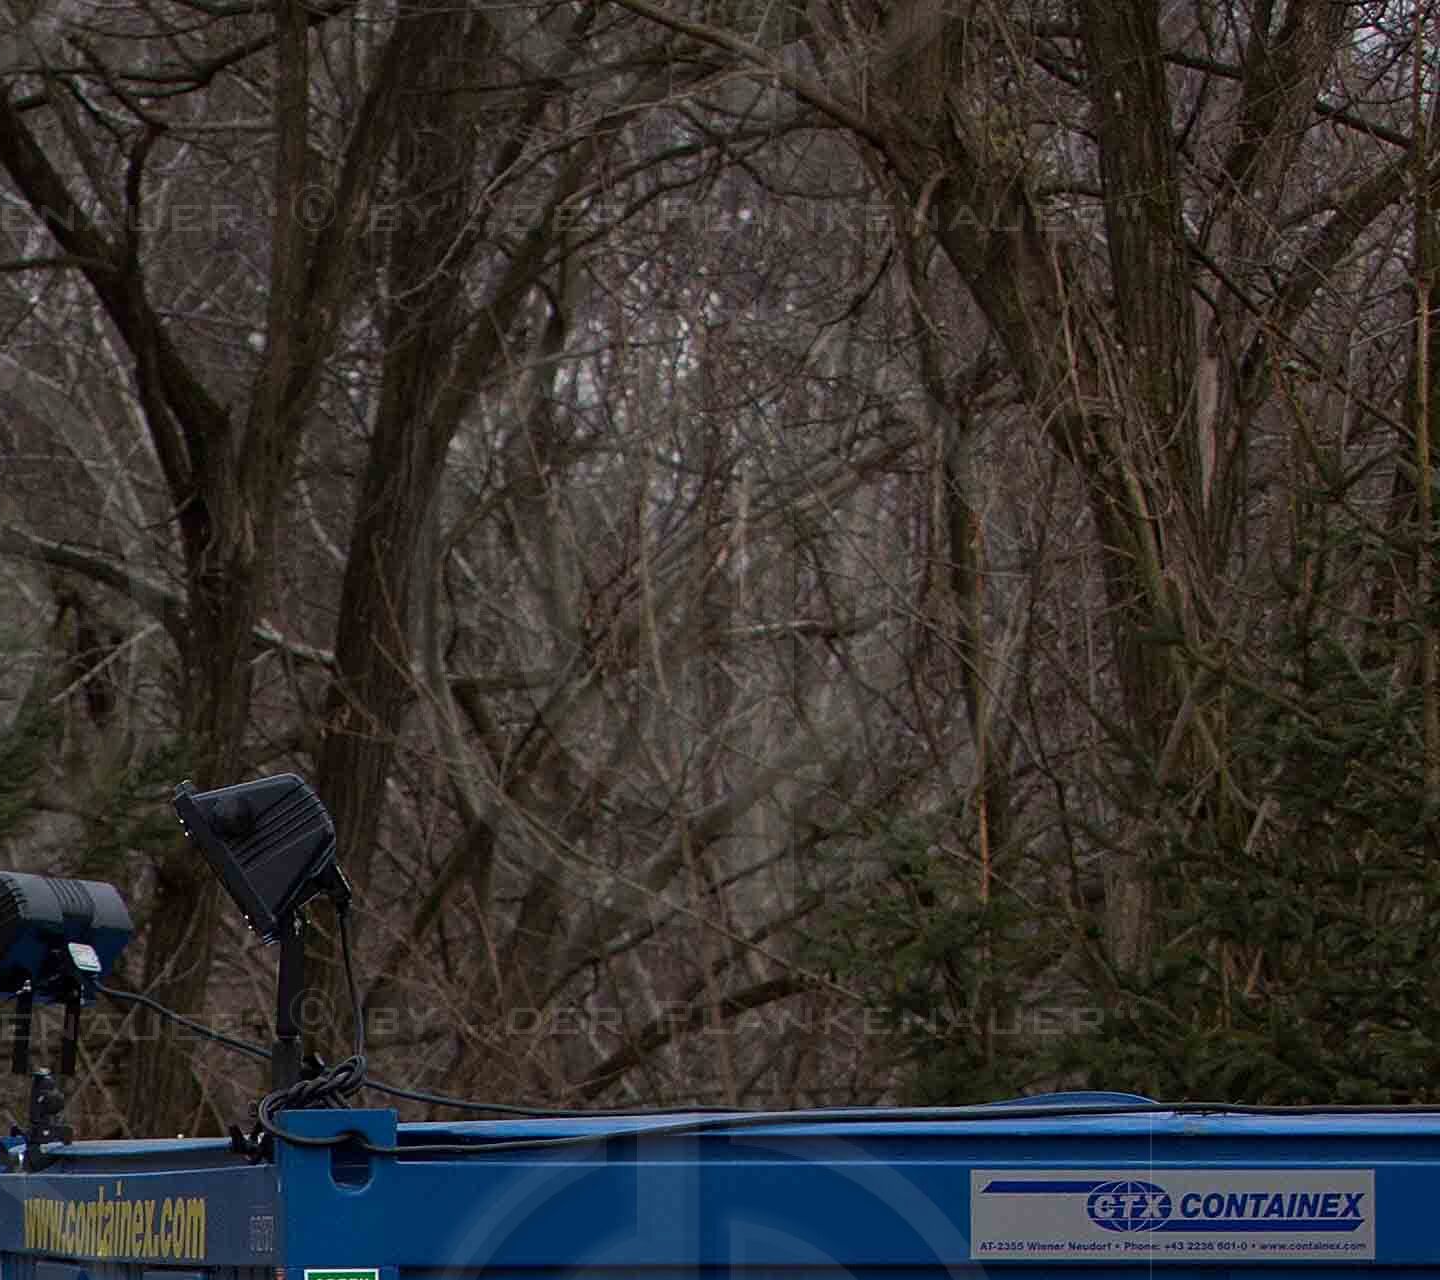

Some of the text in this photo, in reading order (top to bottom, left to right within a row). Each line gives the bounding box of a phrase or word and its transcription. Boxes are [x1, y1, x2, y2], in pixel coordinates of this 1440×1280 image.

[24, 1180, 206, 1260] www.containex.com
[1094, 1192, 1365, 1218] CTX CONTAINEX
